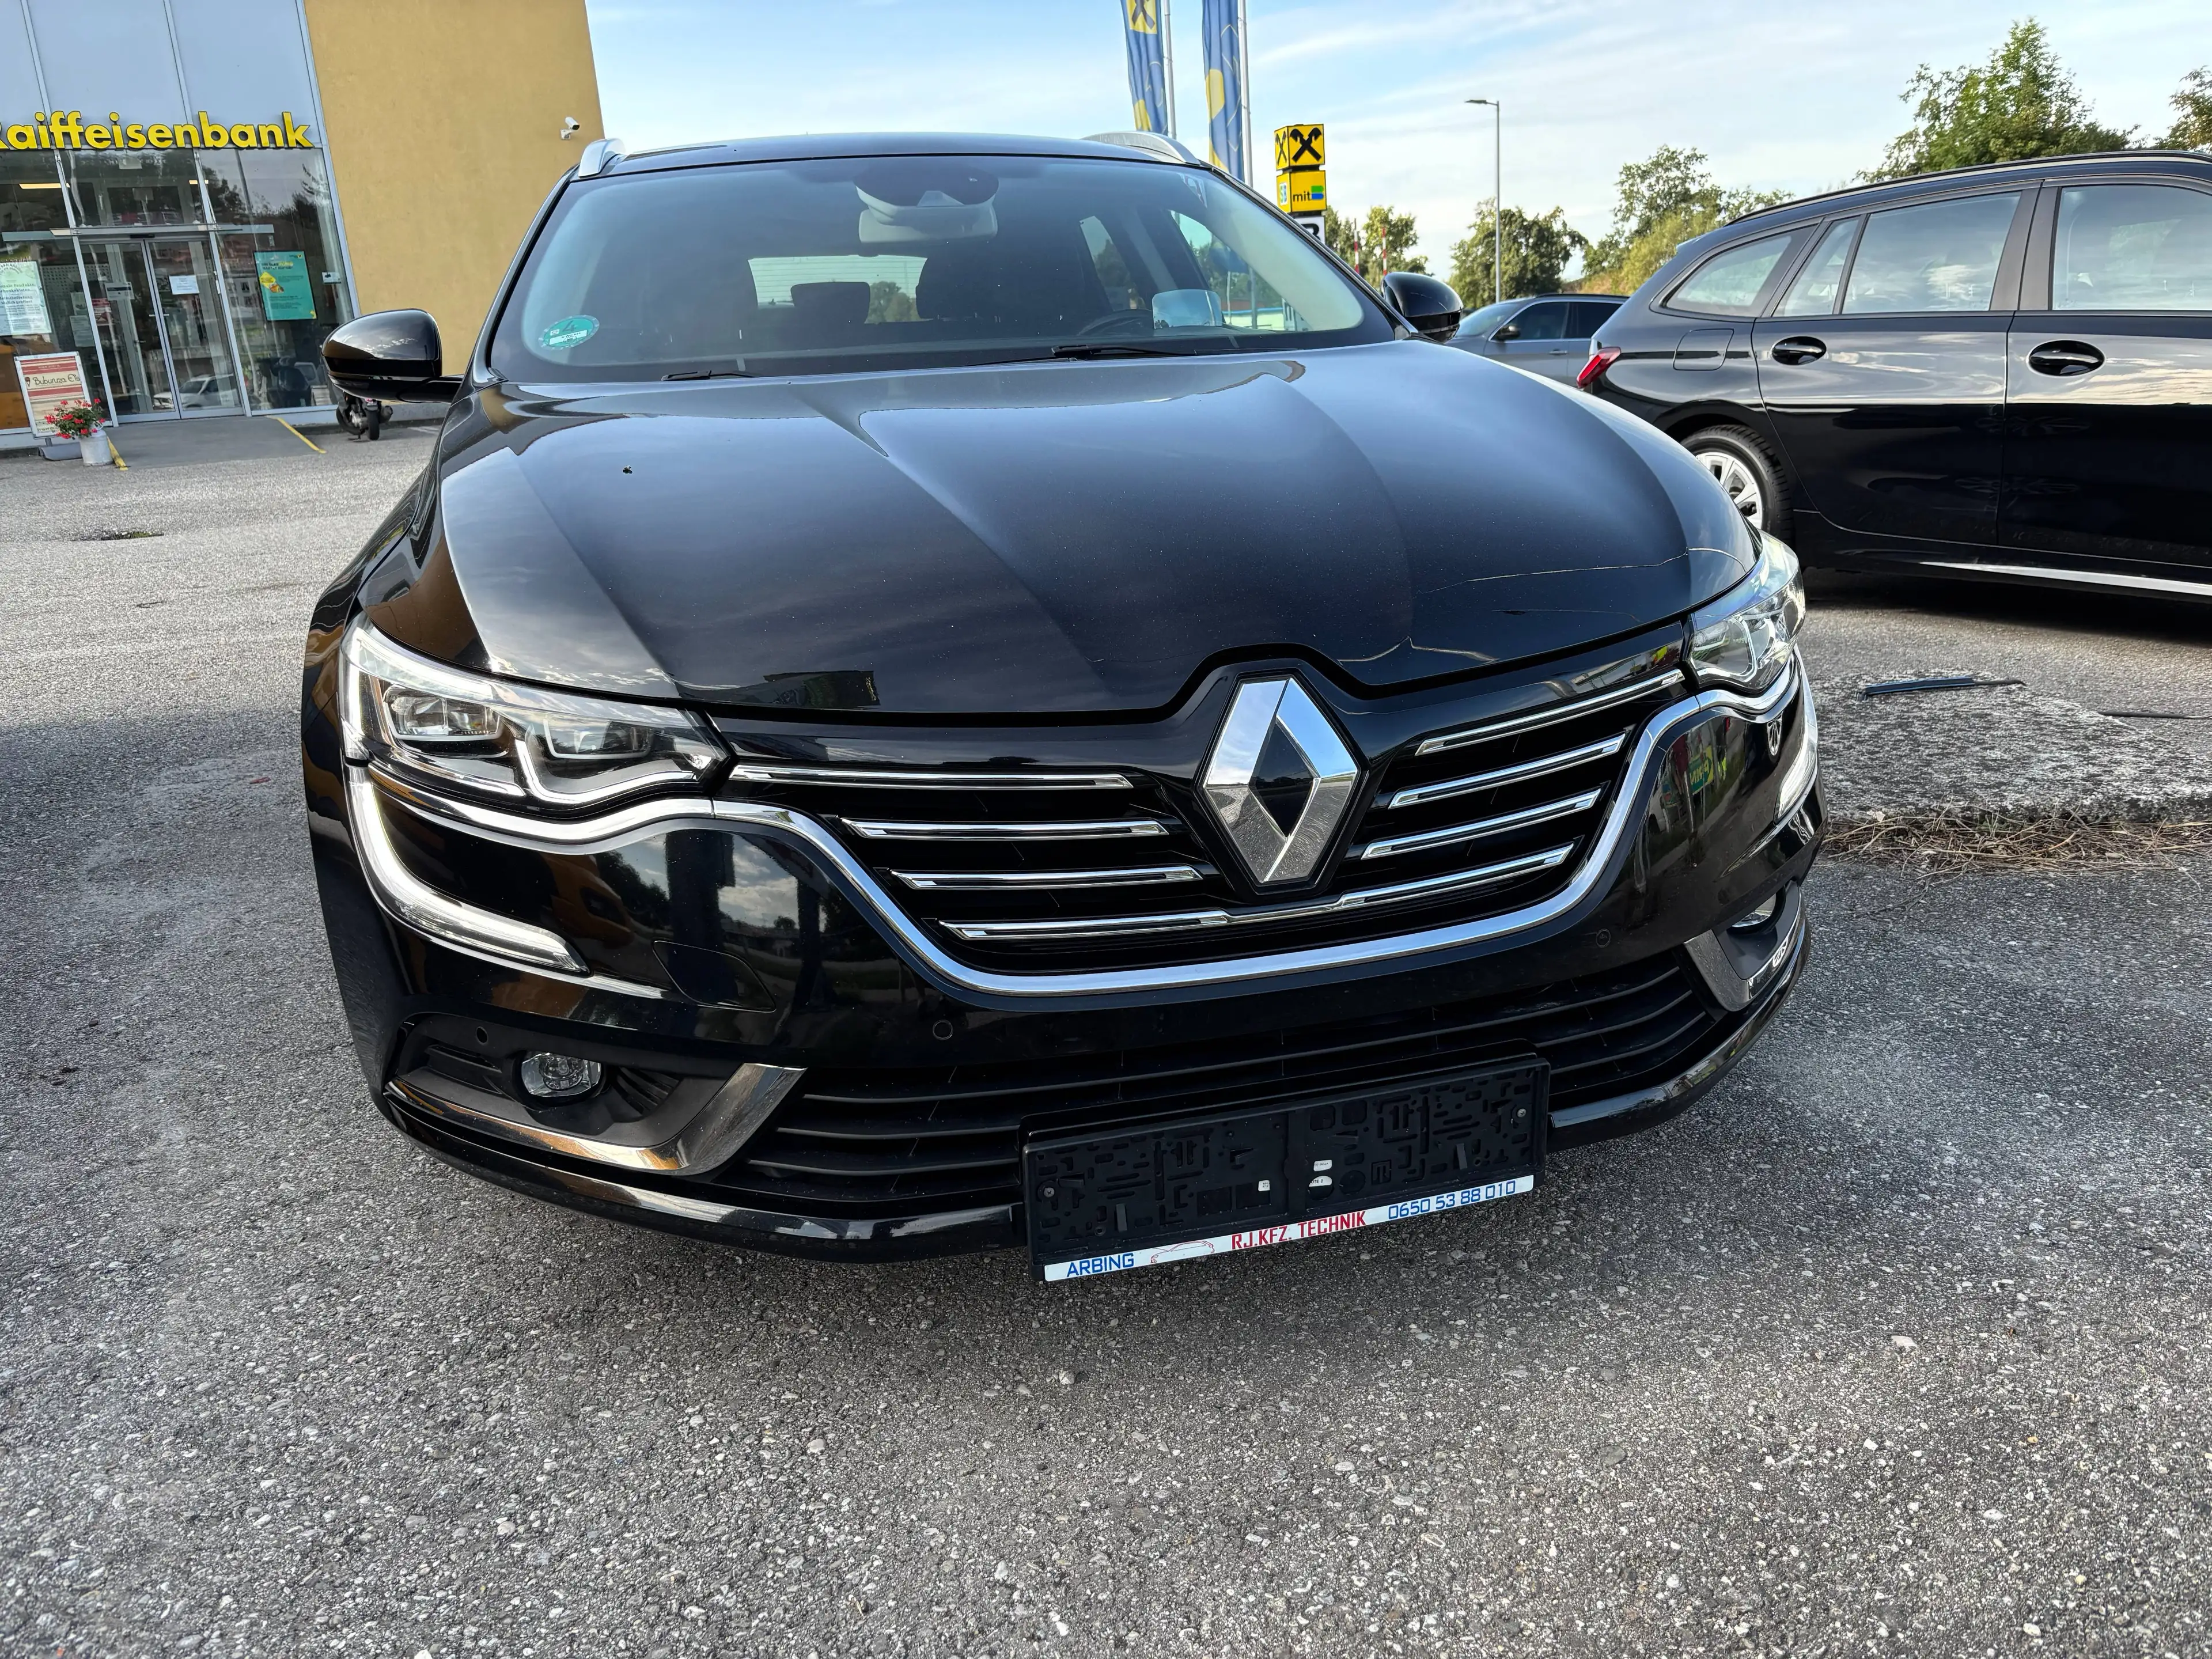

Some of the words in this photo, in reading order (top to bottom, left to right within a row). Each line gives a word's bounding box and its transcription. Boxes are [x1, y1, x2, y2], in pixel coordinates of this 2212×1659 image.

[1293, 191, 1310, 202] mit
[1067, 1252, 1134, 1278] ARBING
[1298, 1210, 1366, 1238] TECHNIK
[1388, 1198, 1431, 1220] 0650
[1435, 1193, 1455, 1210] 53
[1460, 1187, 1481, 1205] 88
[1485, 1180, 1516, 1199] 010
